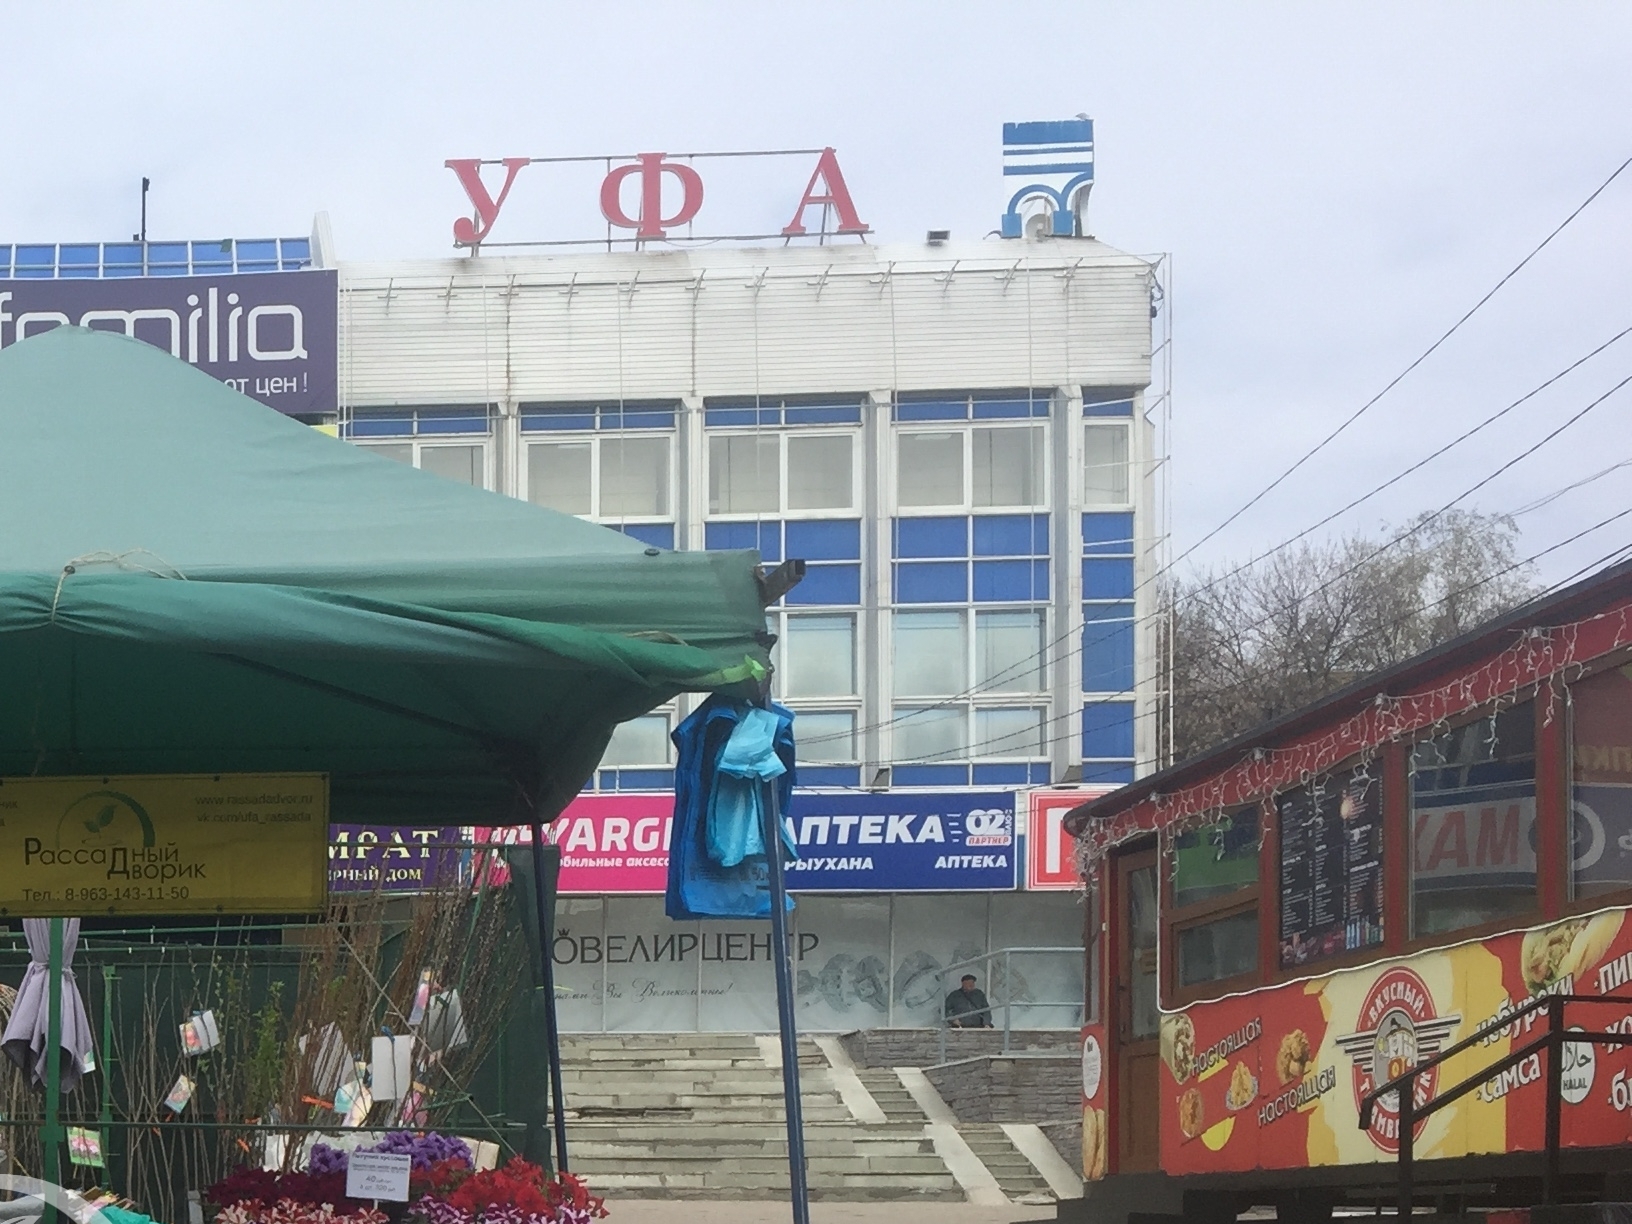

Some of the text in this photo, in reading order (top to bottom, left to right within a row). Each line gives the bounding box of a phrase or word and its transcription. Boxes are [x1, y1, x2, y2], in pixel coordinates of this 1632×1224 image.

[444, 147, 870, 244] УФА
[256, 375, 297, 397] цен
[935, 854, 1008, 869] АПТЕКА
[65, 886, 190, 901] 8-963-143-11-50
[552, 932, 819, 964] ОВЕЛИРЦЕНР
